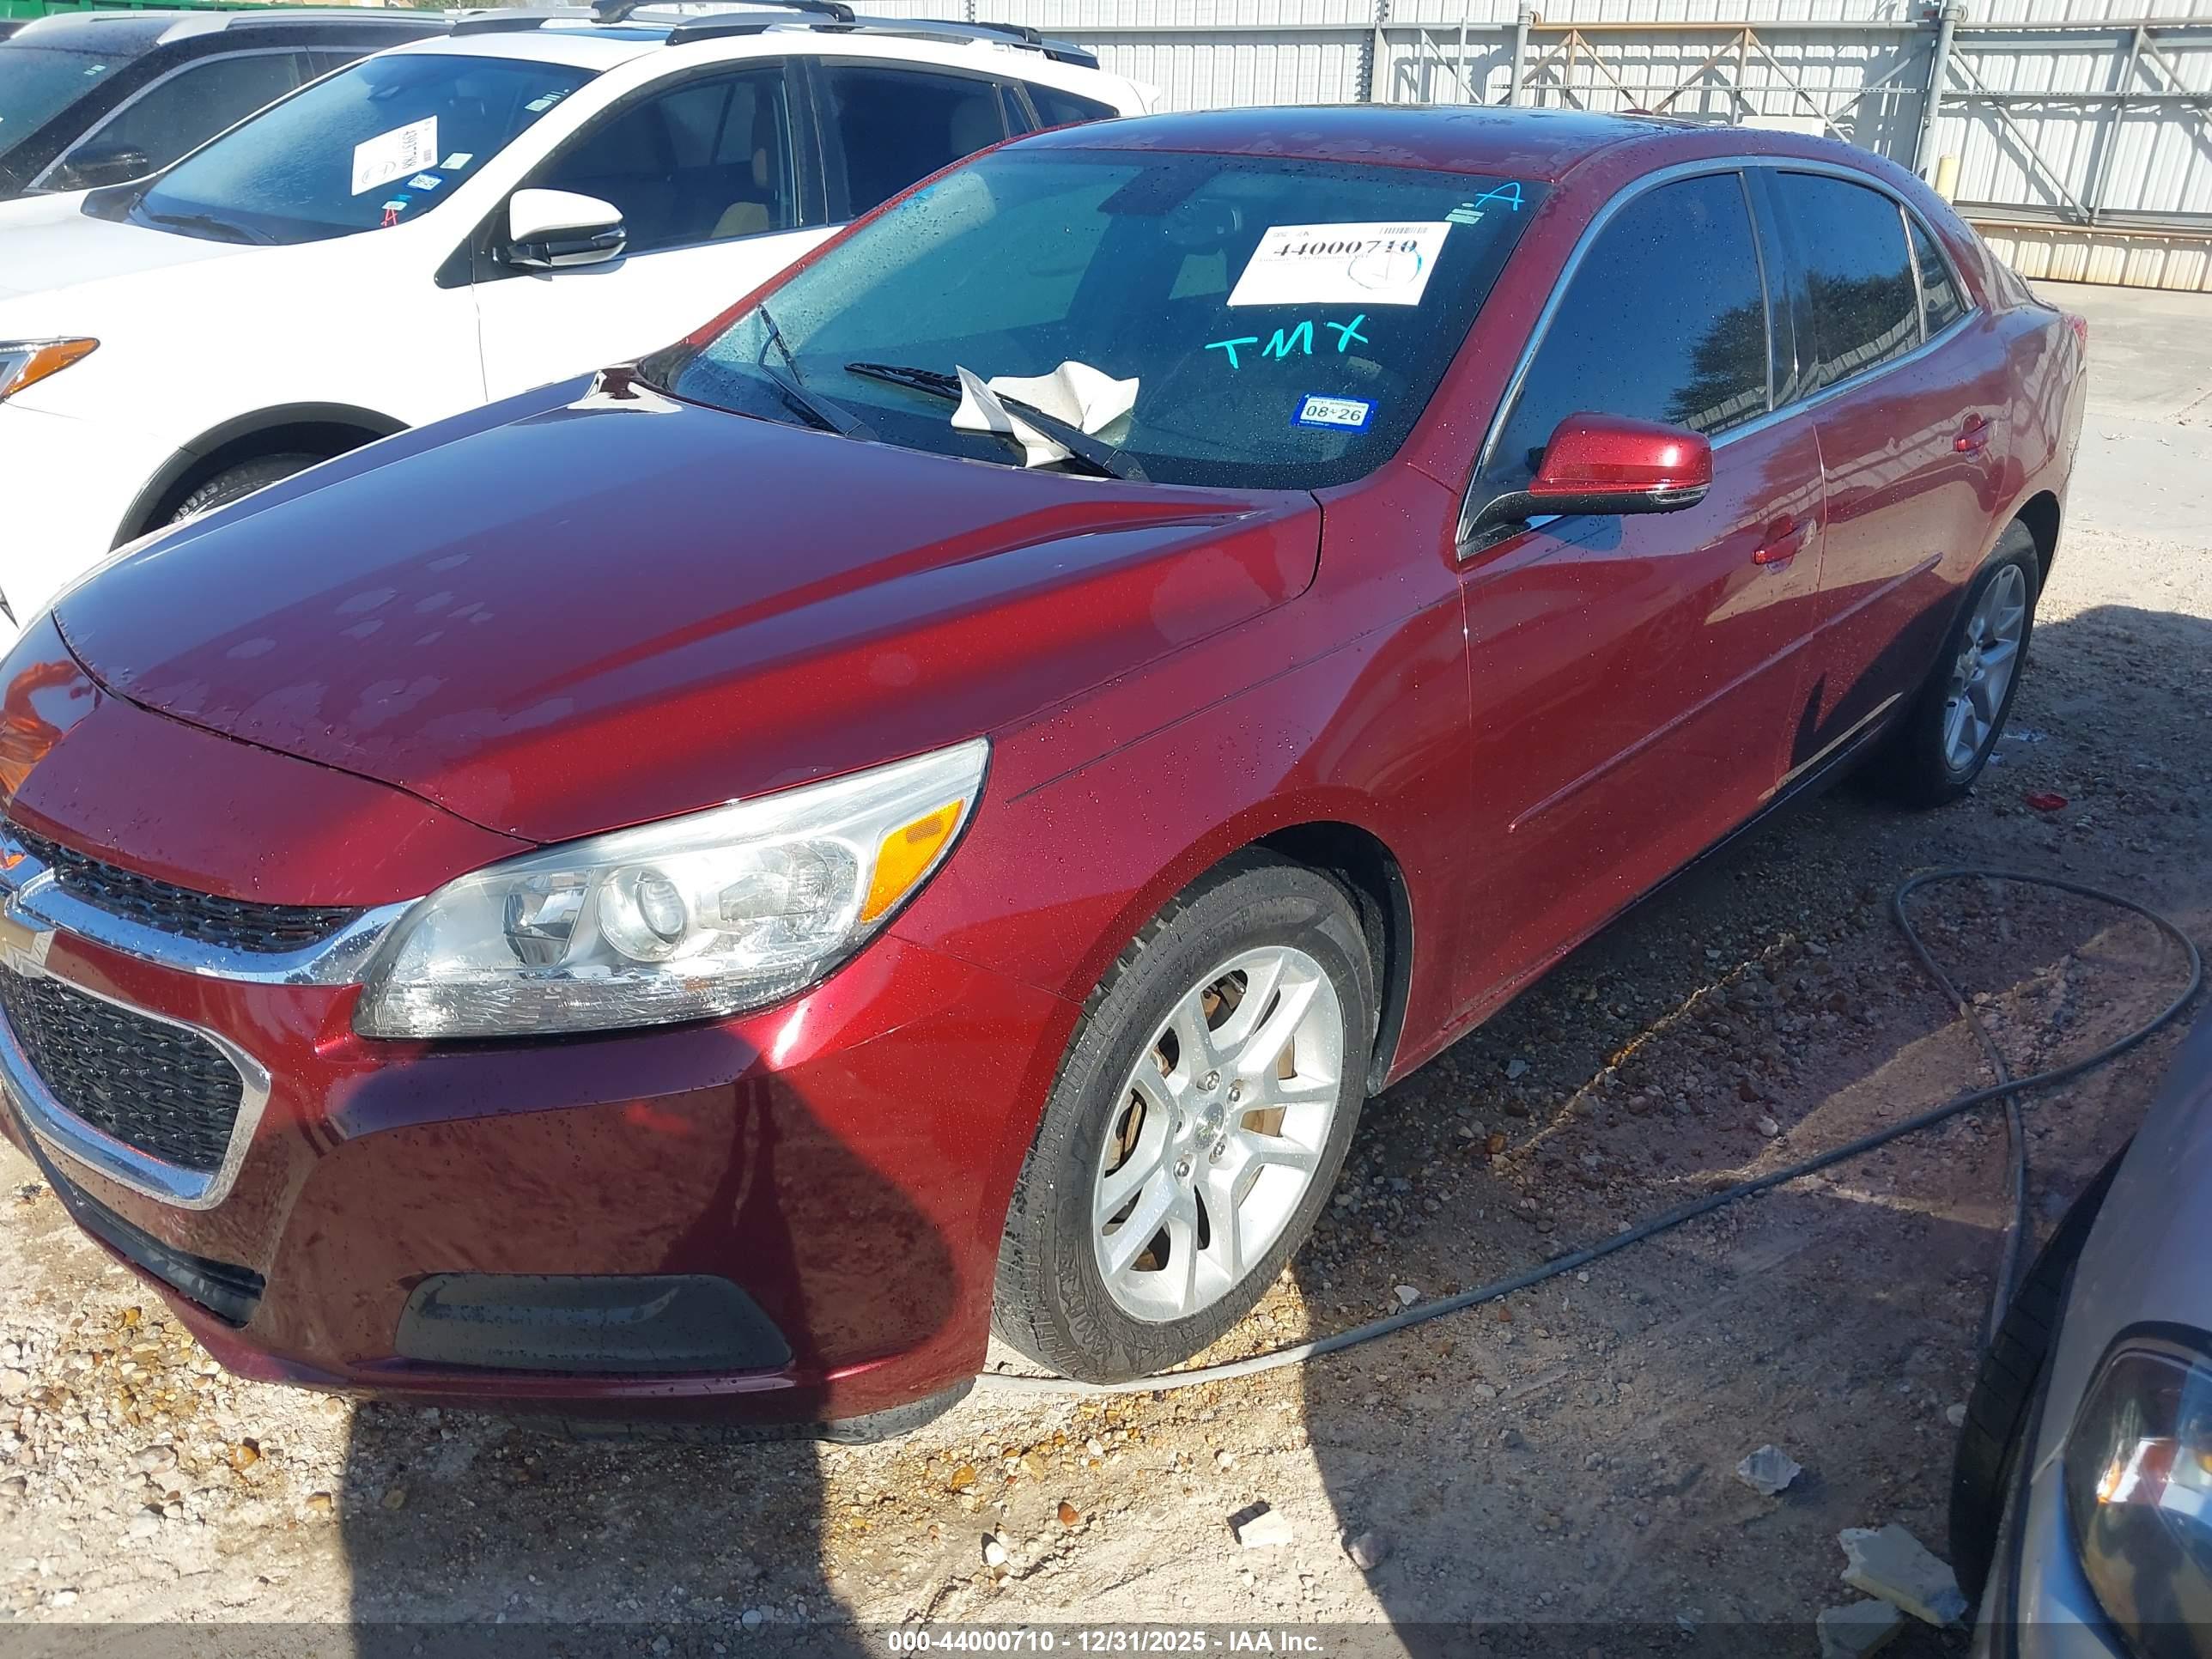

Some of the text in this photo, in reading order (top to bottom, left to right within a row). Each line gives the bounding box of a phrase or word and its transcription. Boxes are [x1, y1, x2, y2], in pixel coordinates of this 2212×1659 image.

[1475, 182, 1525, 211] A
[1273, 240, 1418, 257] 44000710
[1205, 314, 1369, 369] TMX
